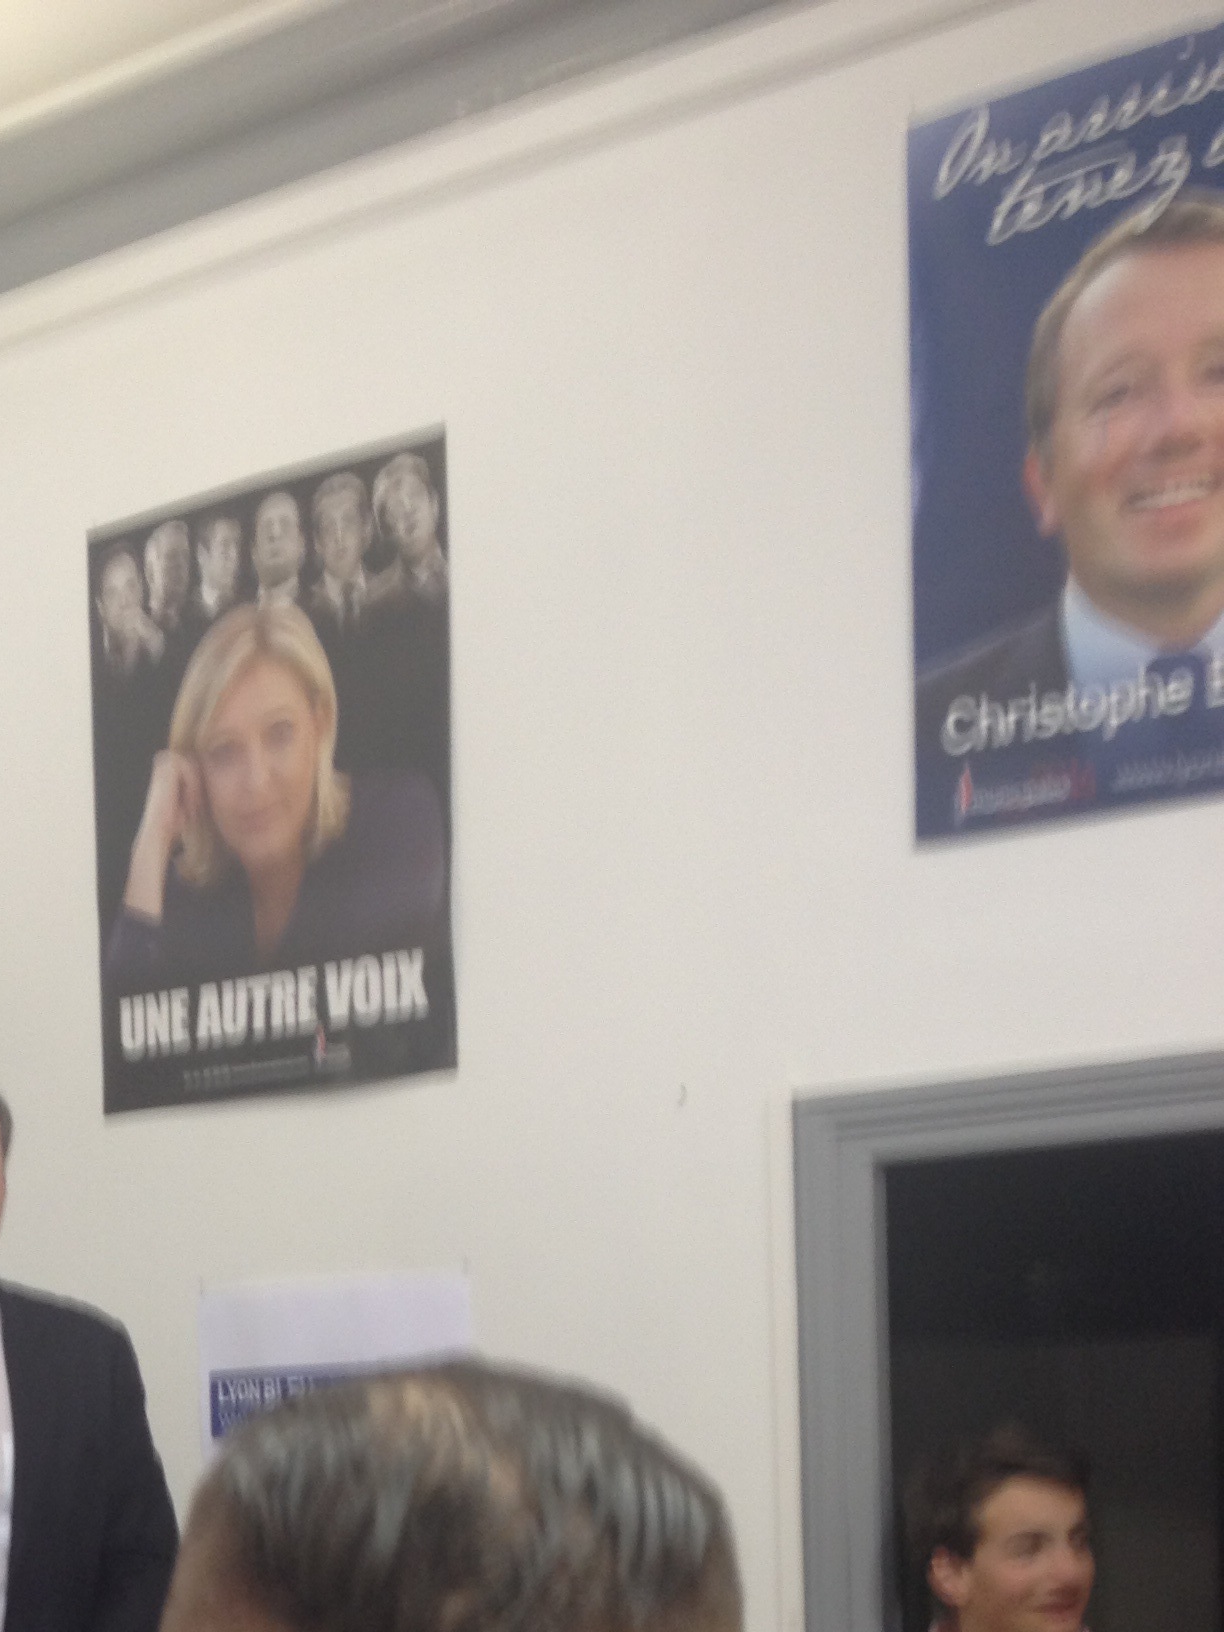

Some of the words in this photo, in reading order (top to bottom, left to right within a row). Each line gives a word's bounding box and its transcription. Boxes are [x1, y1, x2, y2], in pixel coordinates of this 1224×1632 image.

[941, 664, 1195, 756] Christophe
[120, 986, 191, 1062] UNE
[196, 964, 320, 1052] AUTRE
[324, 946, 430, 1032] VOIX
[217, 1377, 260, 1405] LYON
